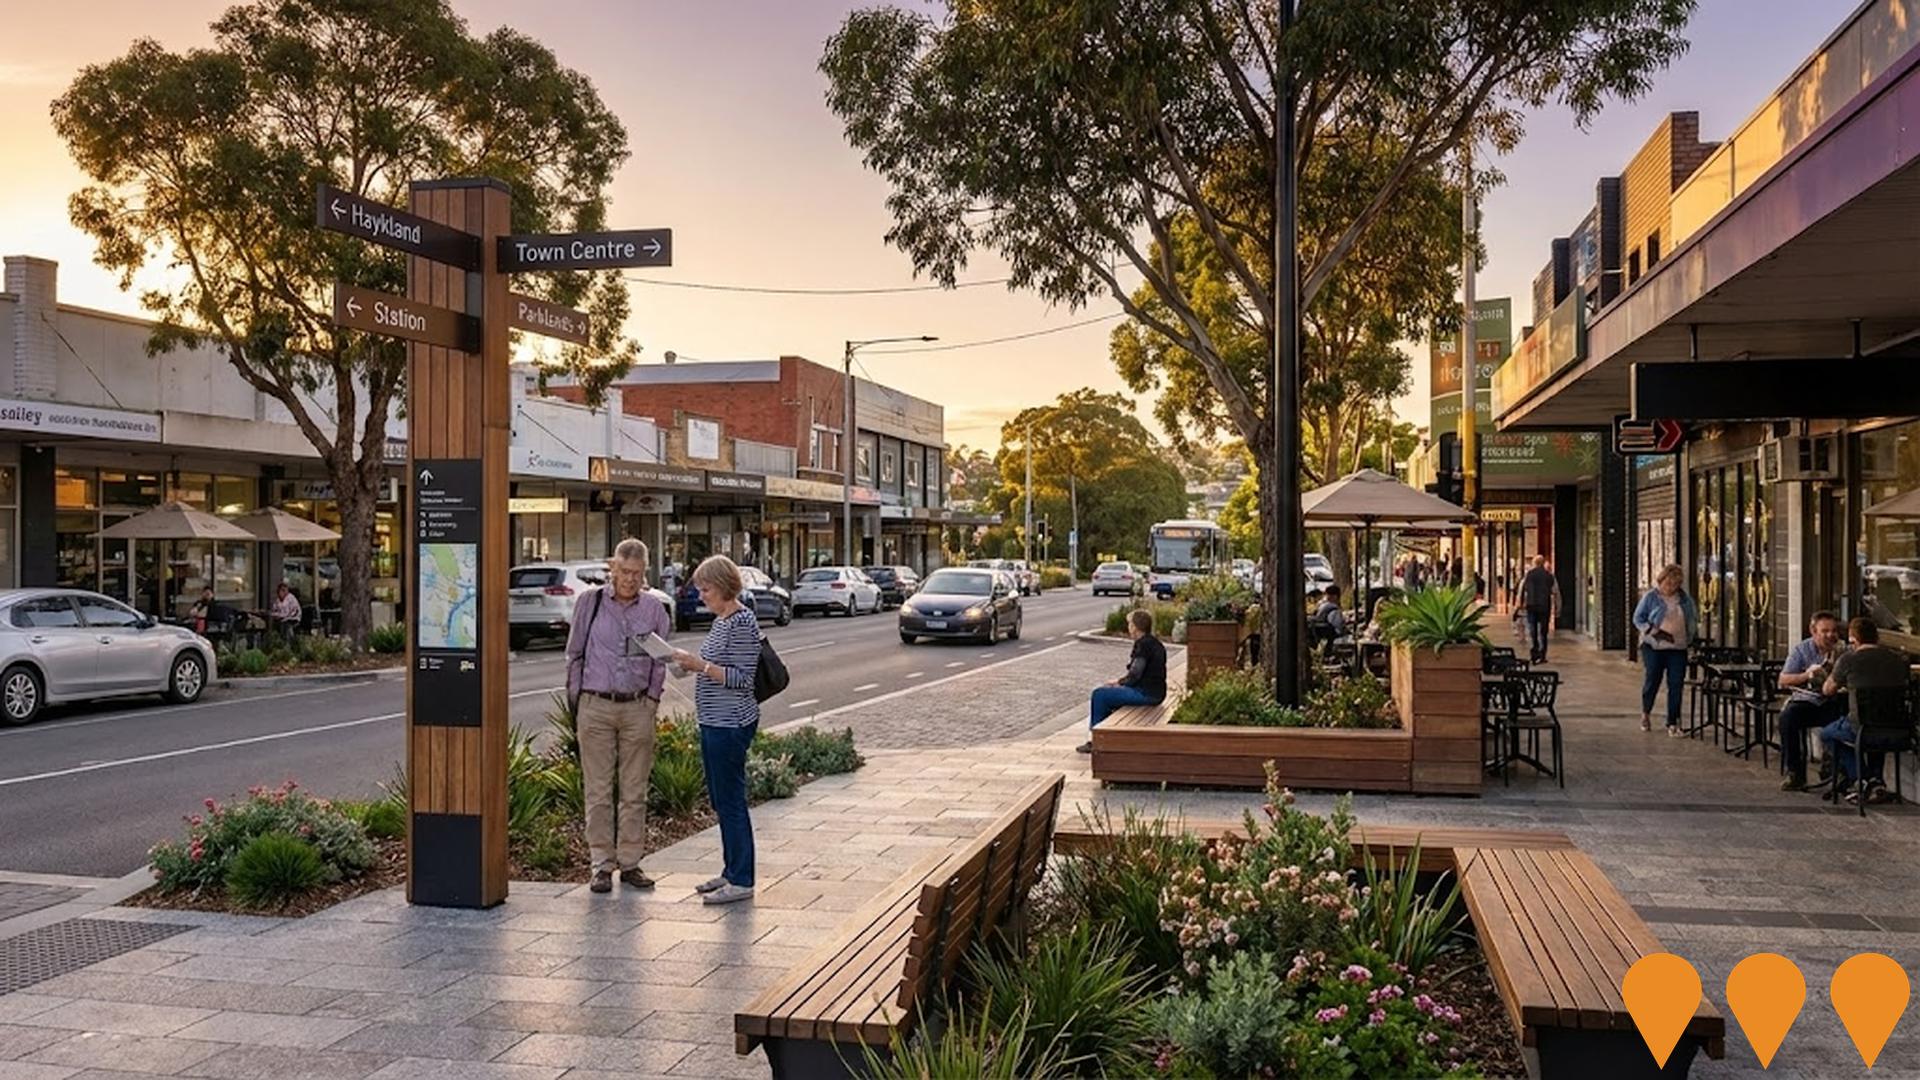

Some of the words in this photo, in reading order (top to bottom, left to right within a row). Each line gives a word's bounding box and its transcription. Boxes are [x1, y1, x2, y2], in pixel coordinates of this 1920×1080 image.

[351, 204, 421, 244] Haykland
[516, 243, 564, 262] Town
[571, 240, 635, 260] Centre
